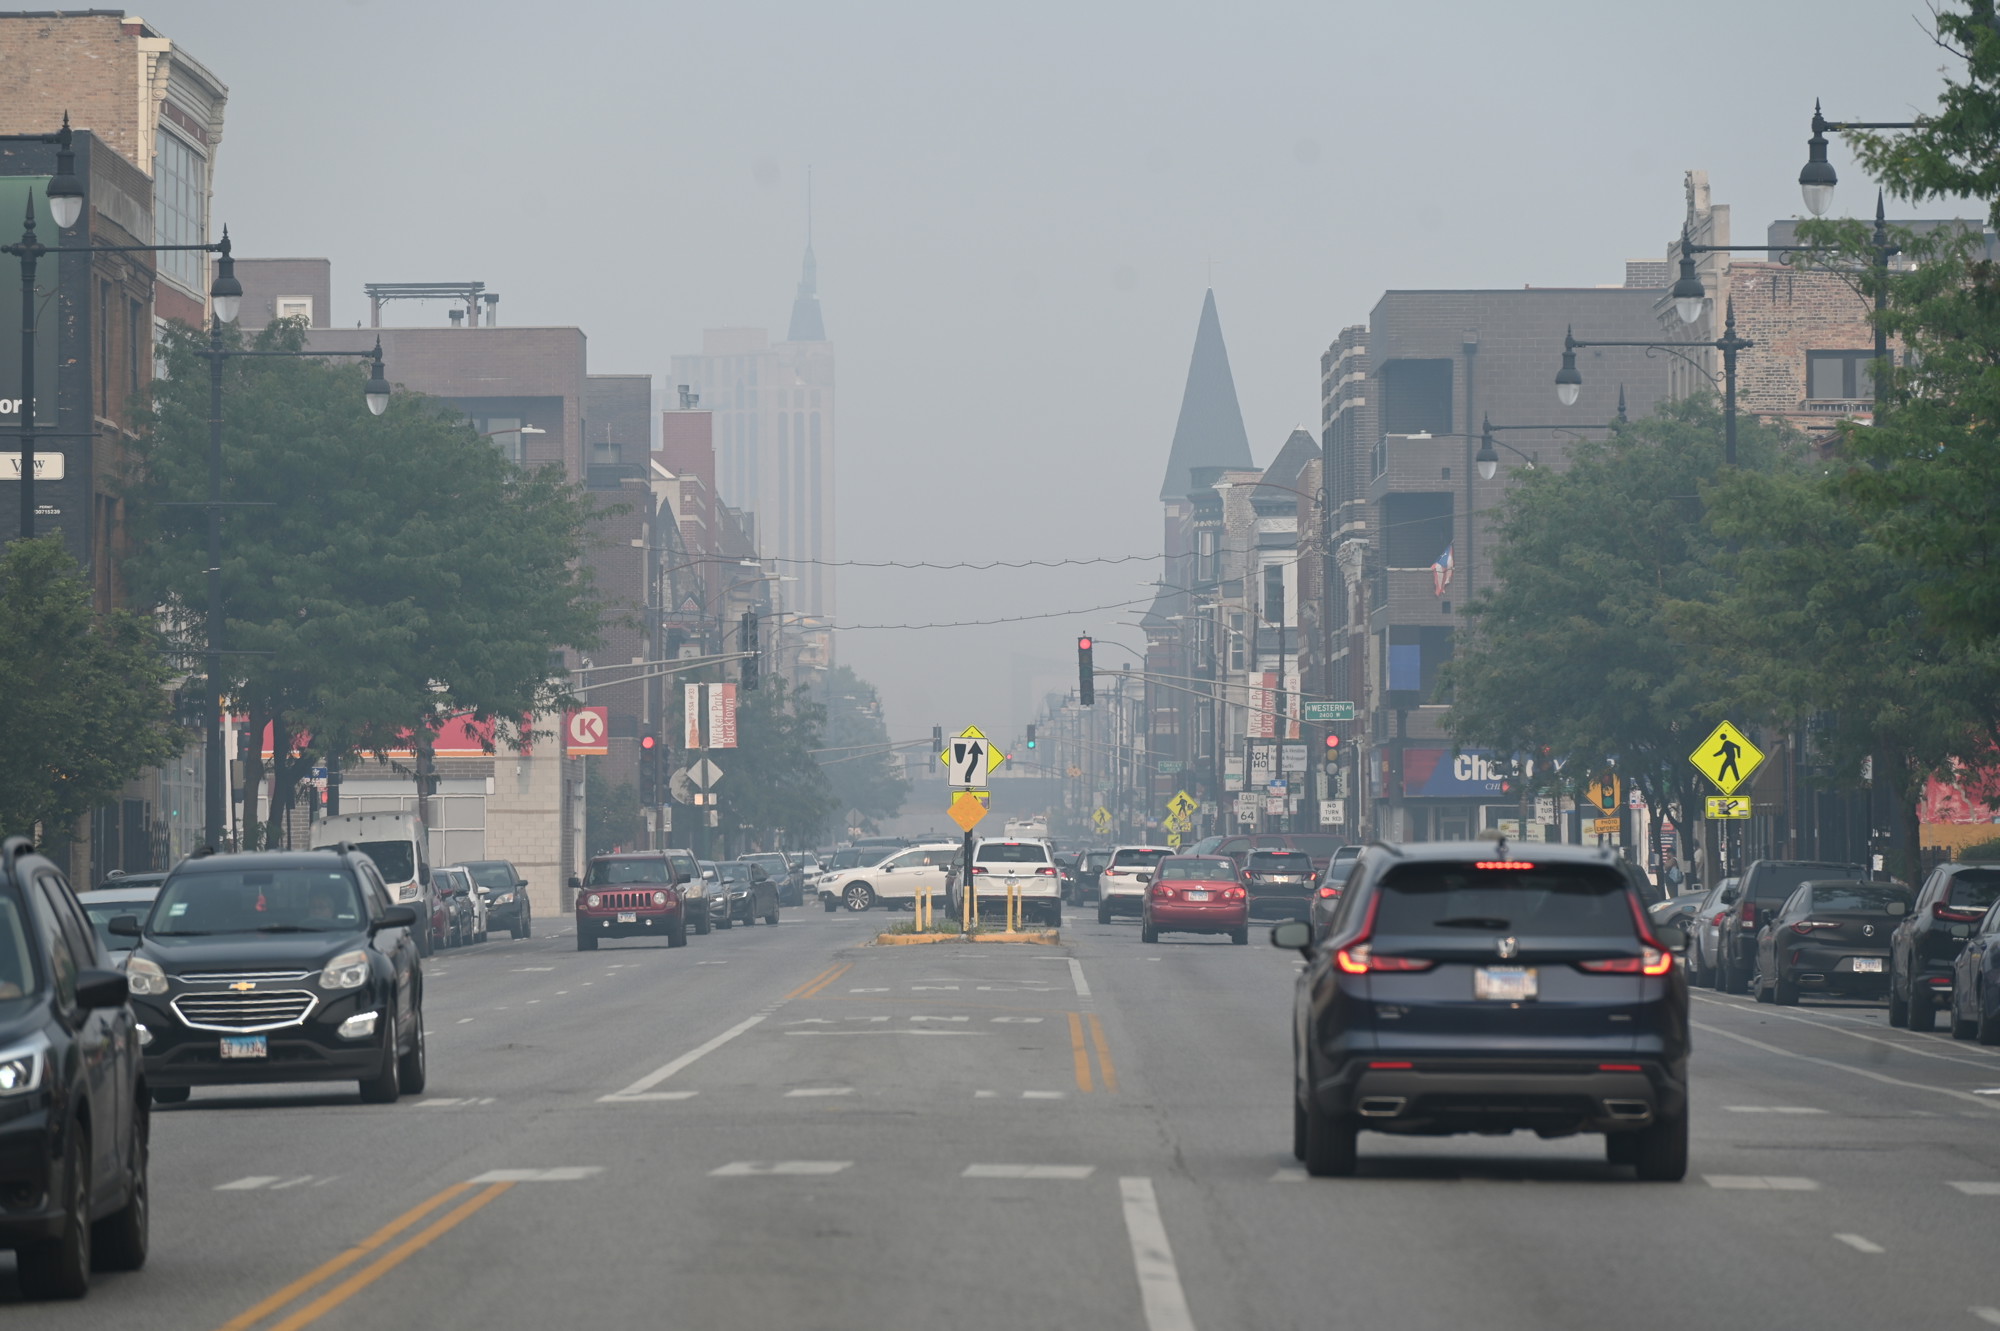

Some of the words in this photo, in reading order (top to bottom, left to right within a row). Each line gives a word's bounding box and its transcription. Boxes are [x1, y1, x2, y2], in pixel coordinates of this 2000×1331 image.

[711, 692, 723, 711] Park
[1311, 704, 1345, 712] WESTERN
[580, 718, 601, 741] K
[711, 715, 723, 745] Wicker
[722, 698, 735, 743] Bucktown
[1249, 703, 1263, 734] Wickr
[1240, 811, 1255, 820] 64
